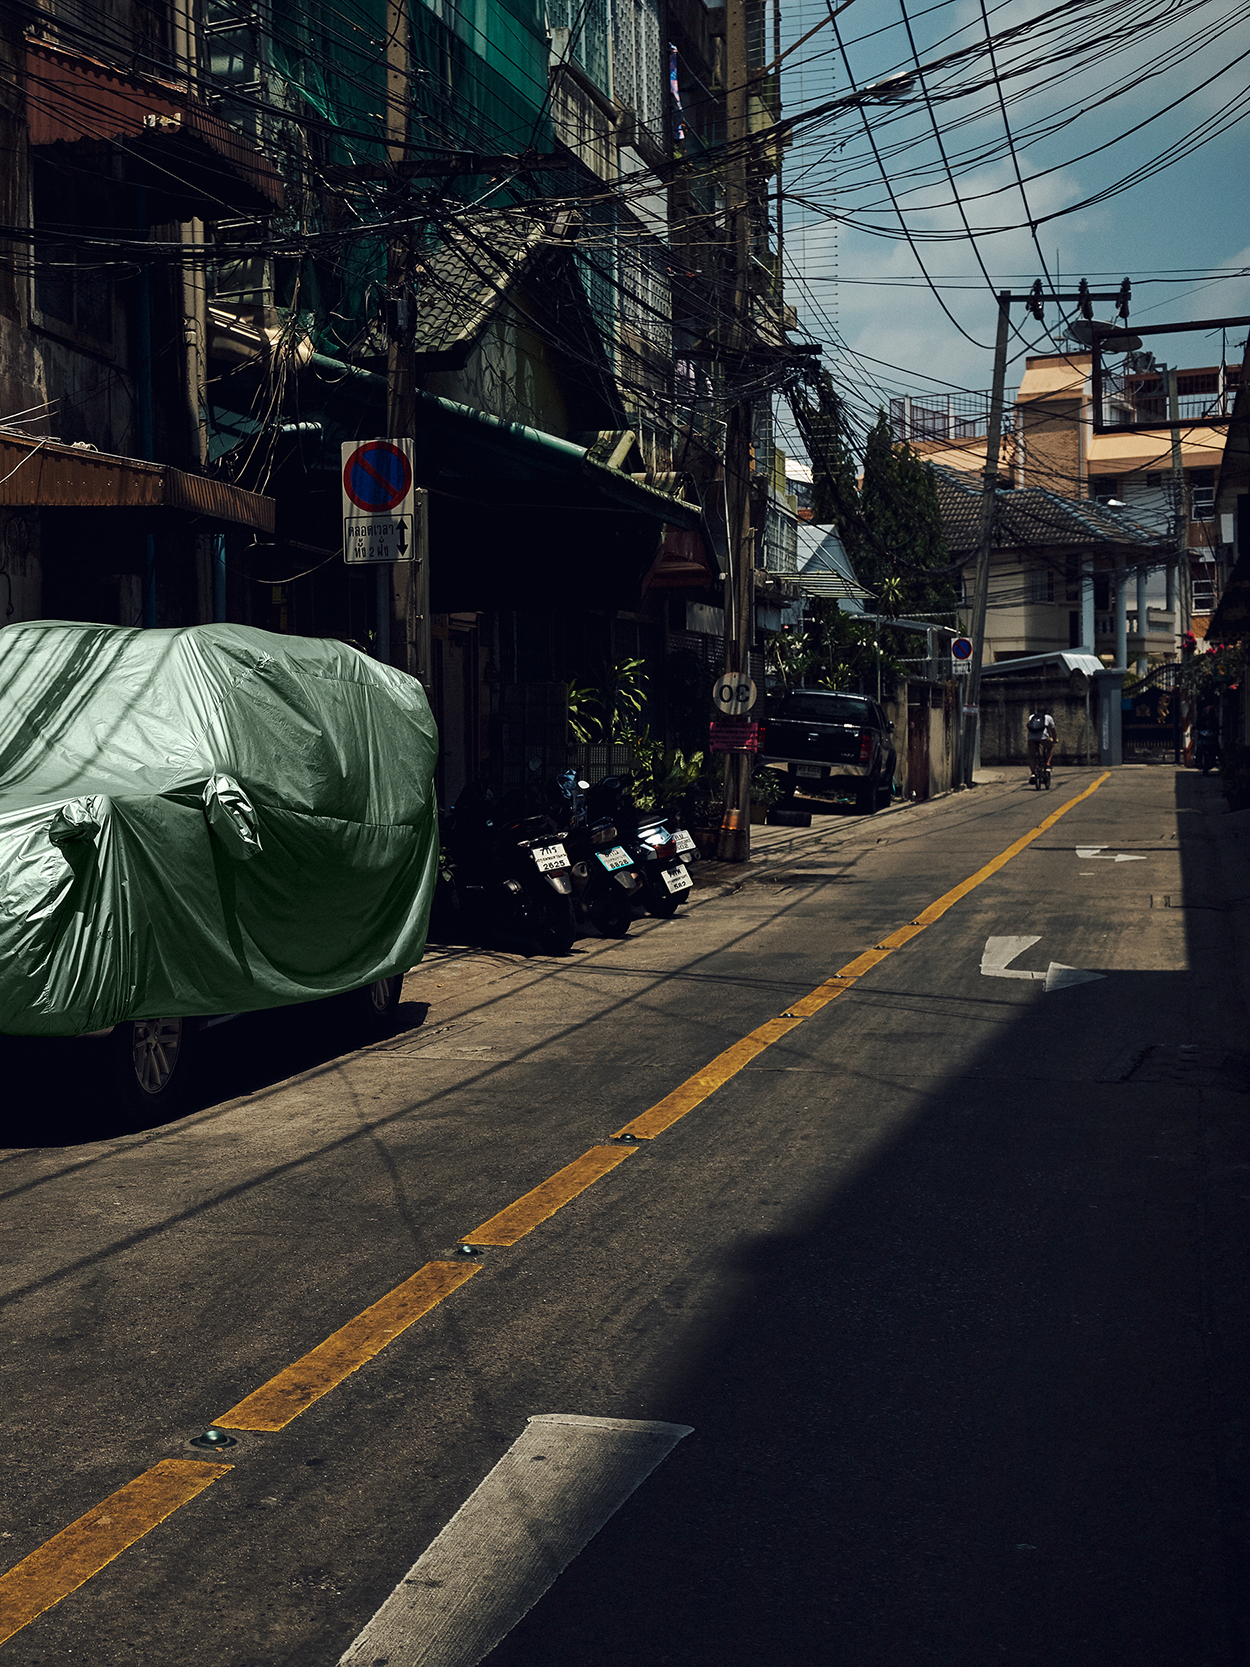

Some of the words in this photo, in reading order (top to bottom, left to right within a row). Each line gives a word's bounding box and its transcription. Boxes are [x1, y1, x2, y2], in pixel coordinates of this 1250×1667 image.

[348, 524, 394, 537] ตลอดเวลา
[354, 538, 366, 558] ทั้ง
[369, 547, 375, 557] 2
[377, 536, 389, 557] ฝั่ง
